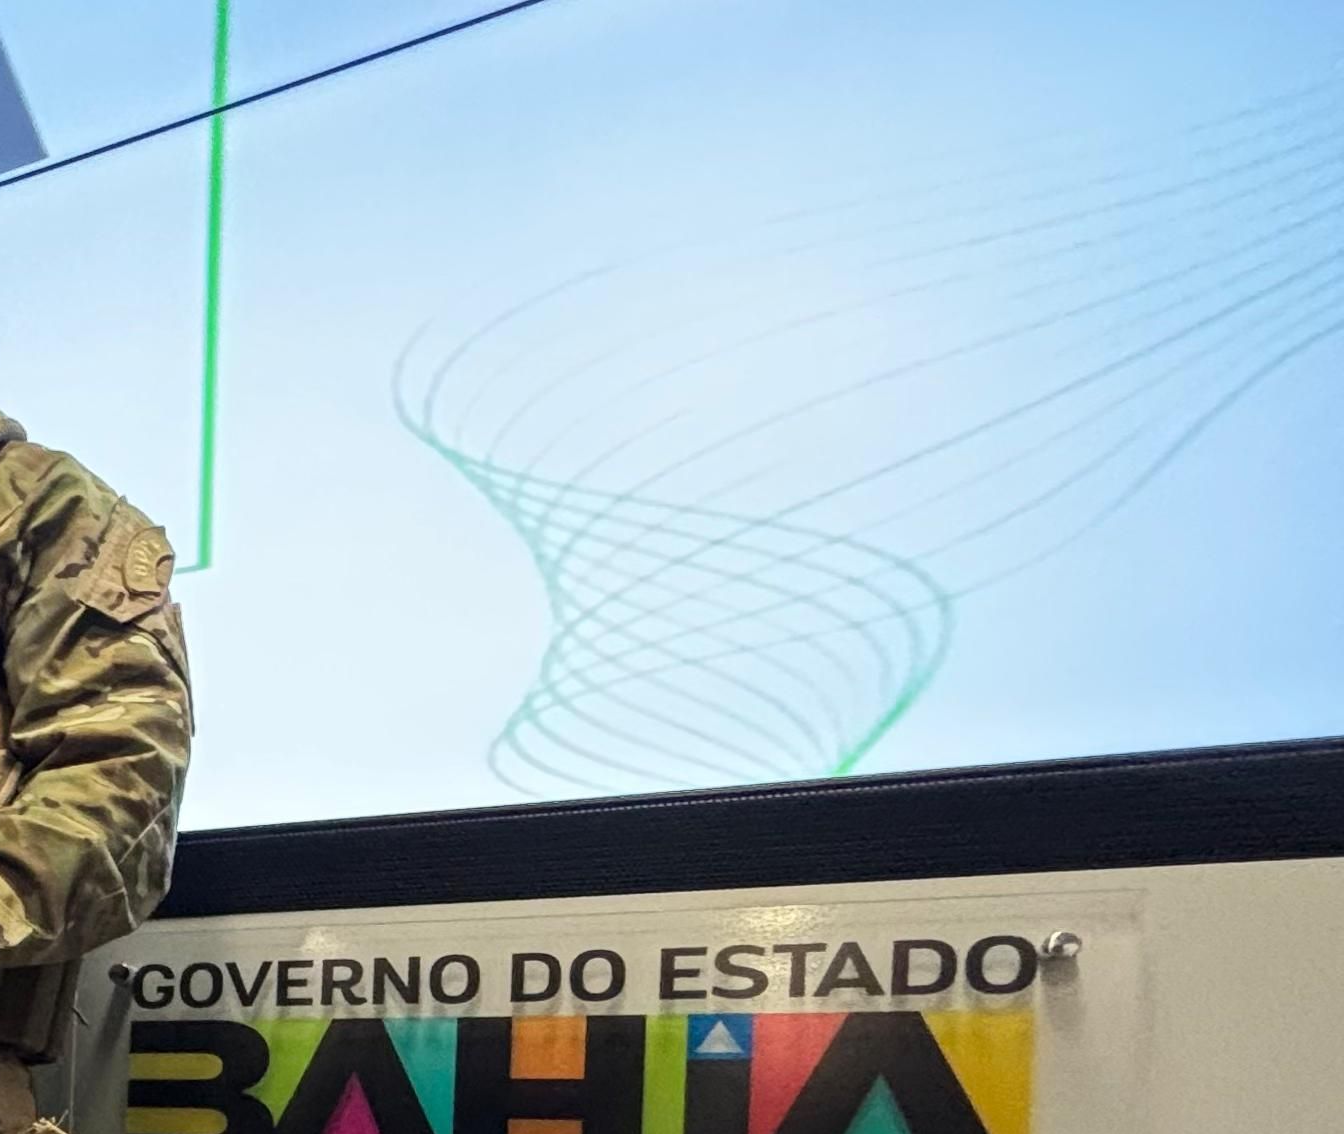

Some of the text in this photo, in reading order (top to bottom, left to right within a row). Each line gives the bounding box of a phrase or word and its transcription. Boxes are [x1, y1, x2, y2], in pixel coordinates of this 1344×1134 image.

[133, 935, 1040, 1010] GOVERNO DO ESTADO
